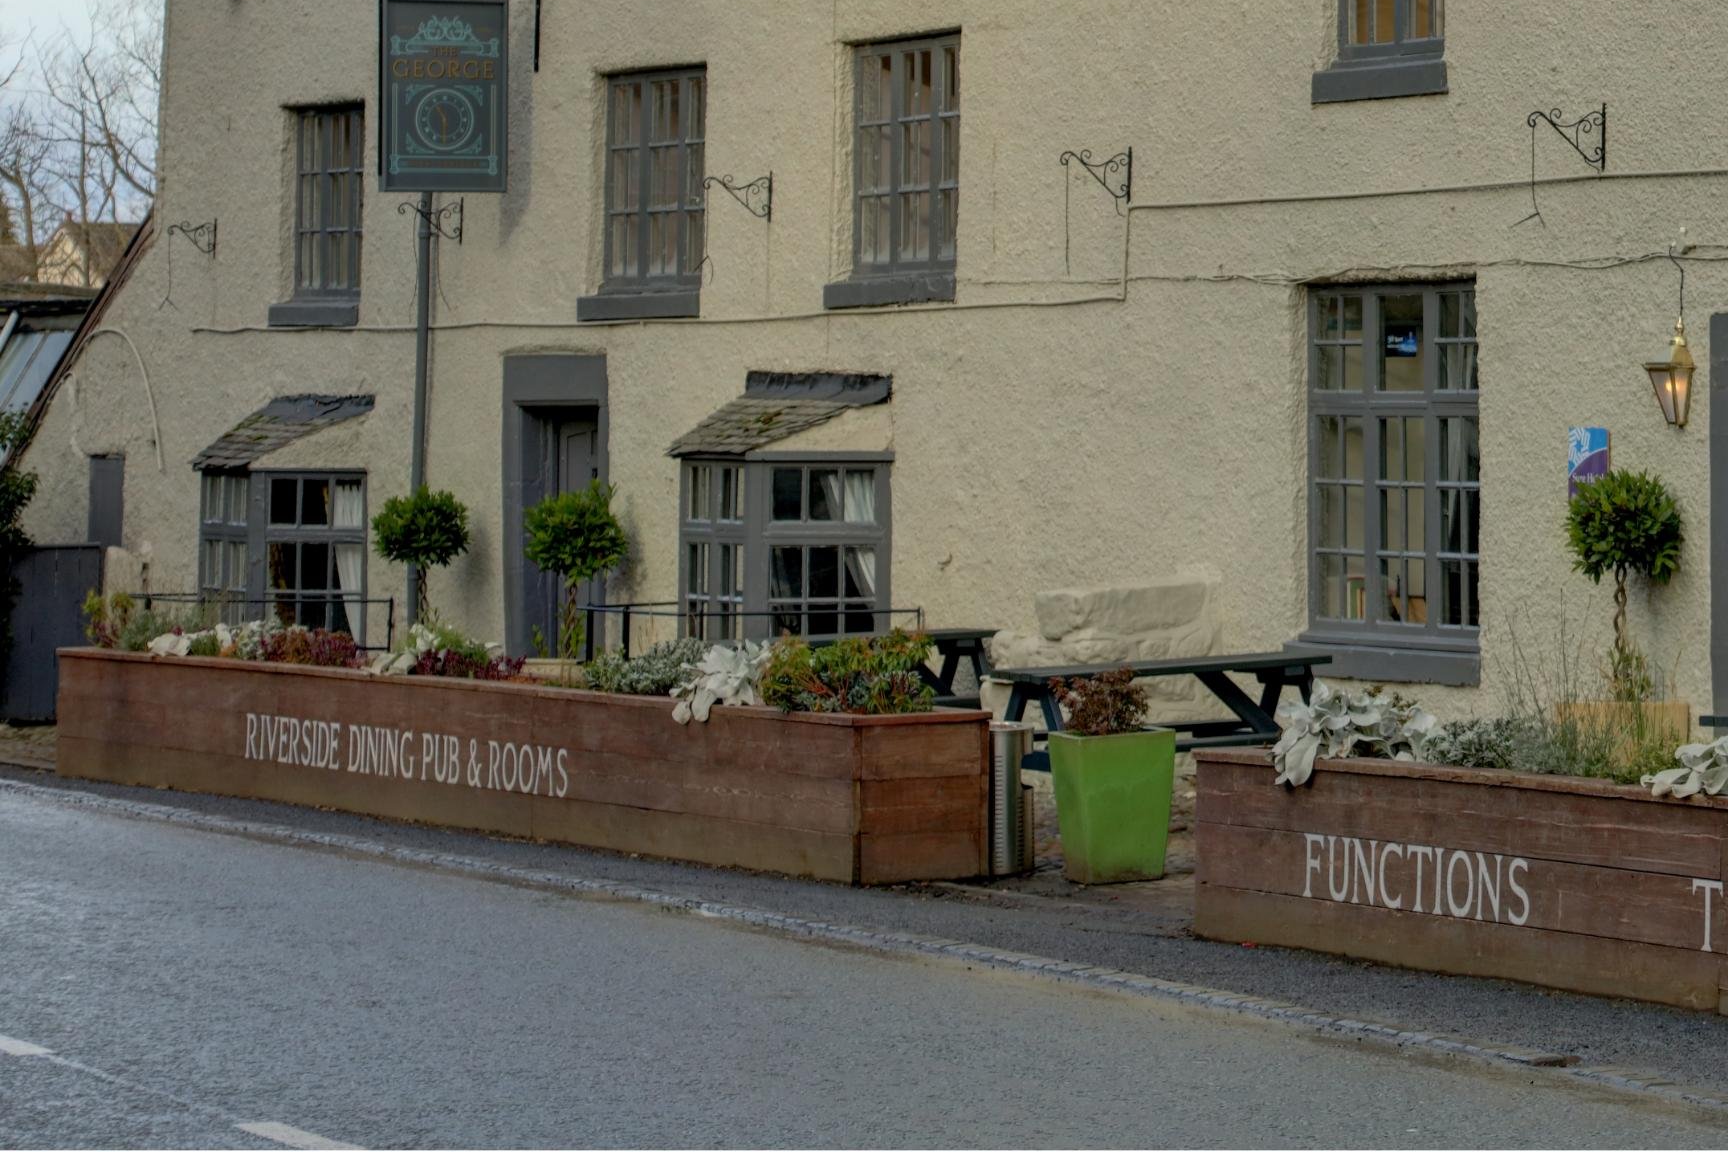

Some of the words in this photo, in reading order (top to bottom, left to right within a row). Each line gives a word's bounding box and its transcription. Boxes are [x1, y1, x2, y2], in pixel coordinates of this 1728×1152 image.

[392, 59, 496, 80] GEORGE
[245, 713, 341, 770] RIVERSIDE
[347, 725, 414, 779] DINING
[421, 733, 460, 785] PUB
[467, 738, 482, 788] &
[487, 741, 569, 798] ROOMS
[1302, 832, 1531, 926] FUNCTIONS
